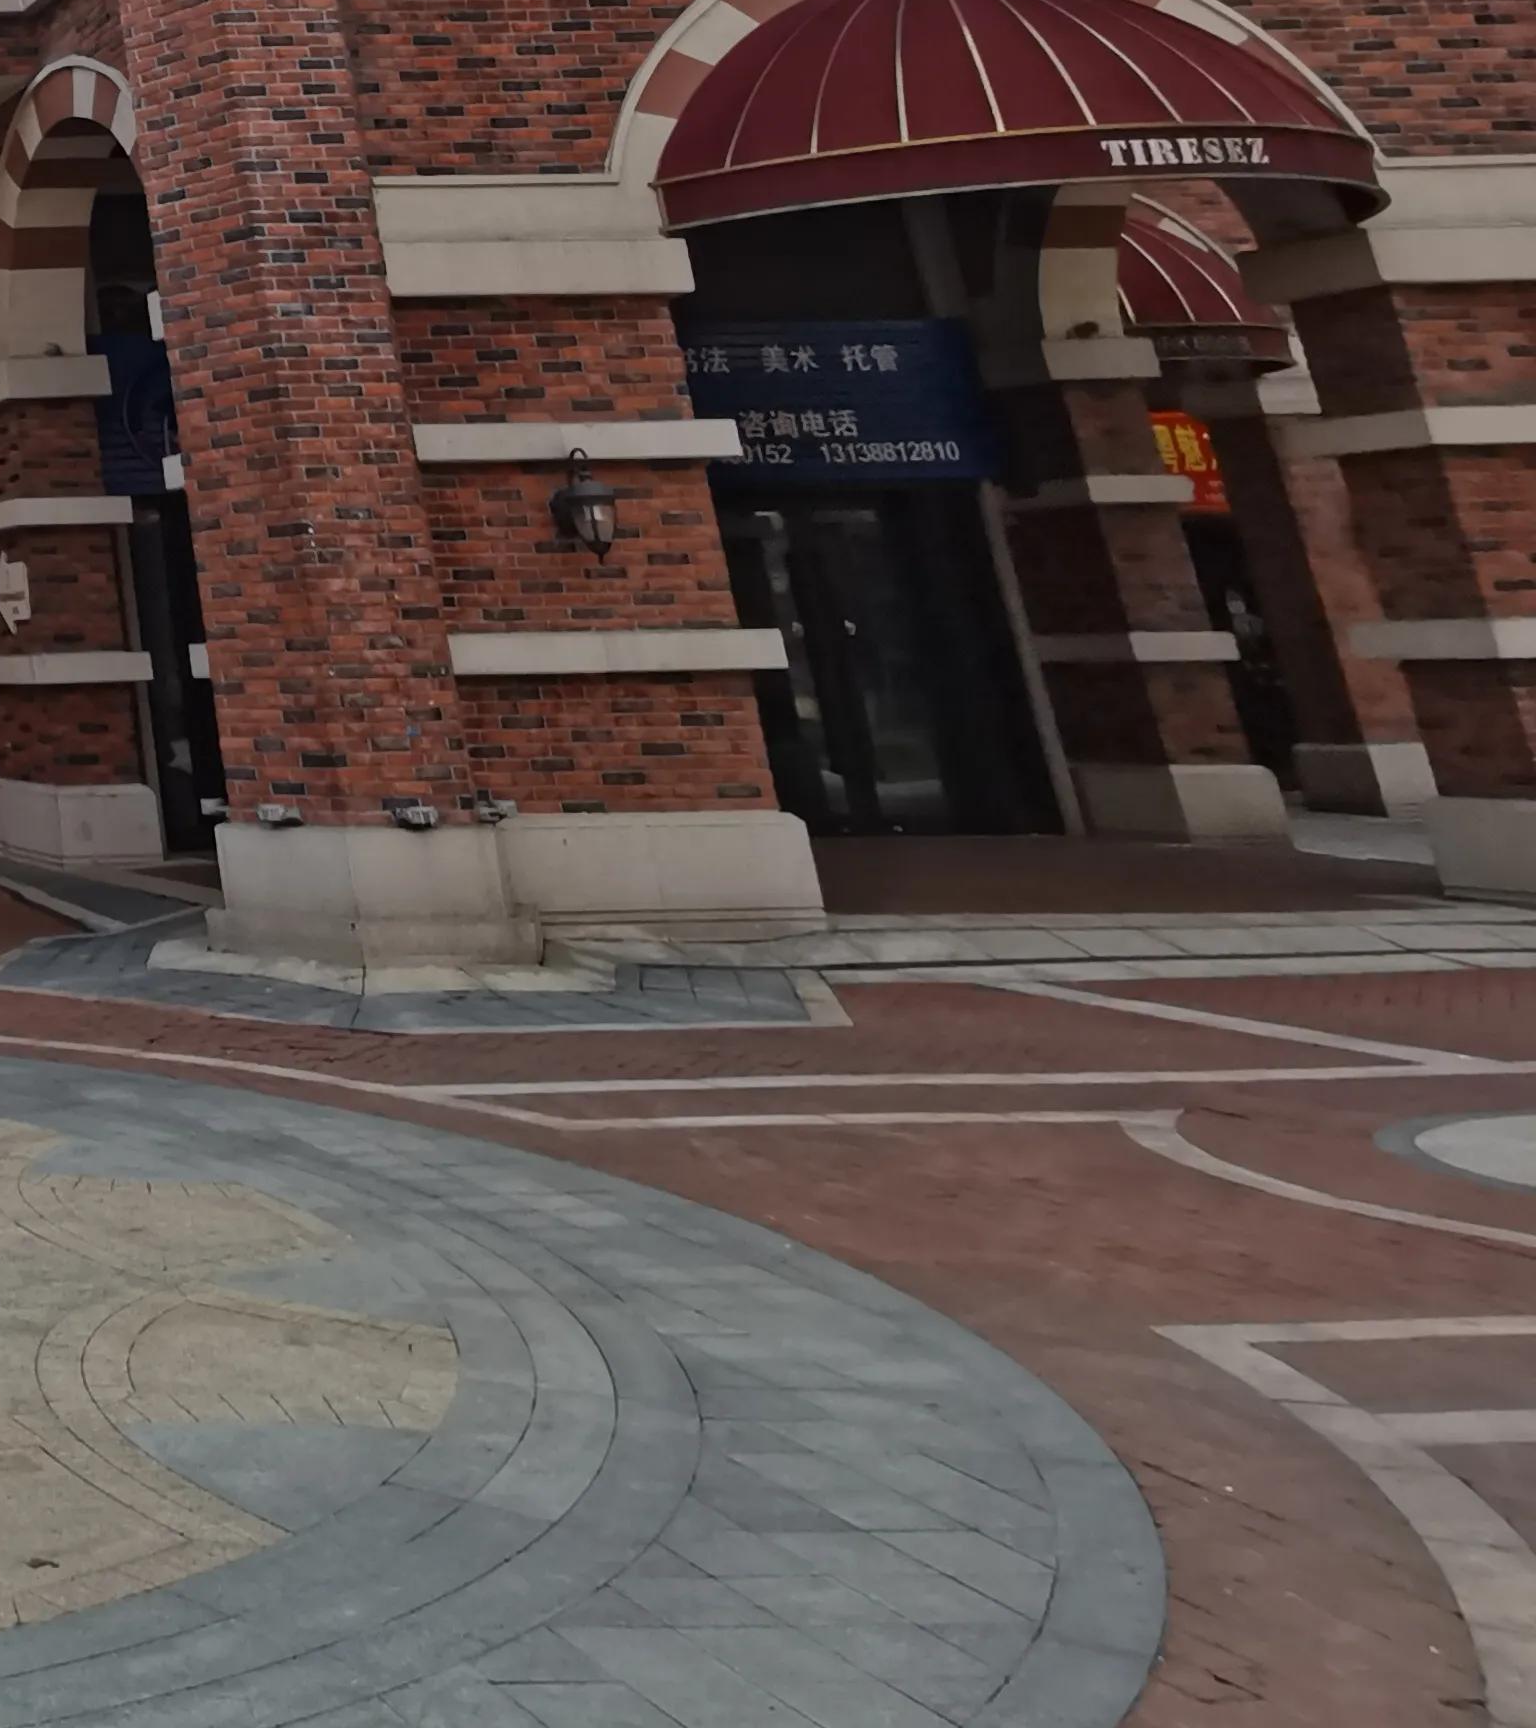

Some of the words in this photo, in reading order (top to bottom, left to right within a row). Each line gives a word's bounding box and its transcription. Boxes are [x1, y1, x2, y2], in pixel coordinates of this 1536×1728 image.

[1100, 137, 1270, 167] TIRESEZ
[760, 343, 820, 374] 美术
[840, 343, 899, 373] 托管
[739, 408, 860, 439] 咨询电话
[721, 443, 796, 466] 0152
[819, 440, 960, 464] 13138812810
